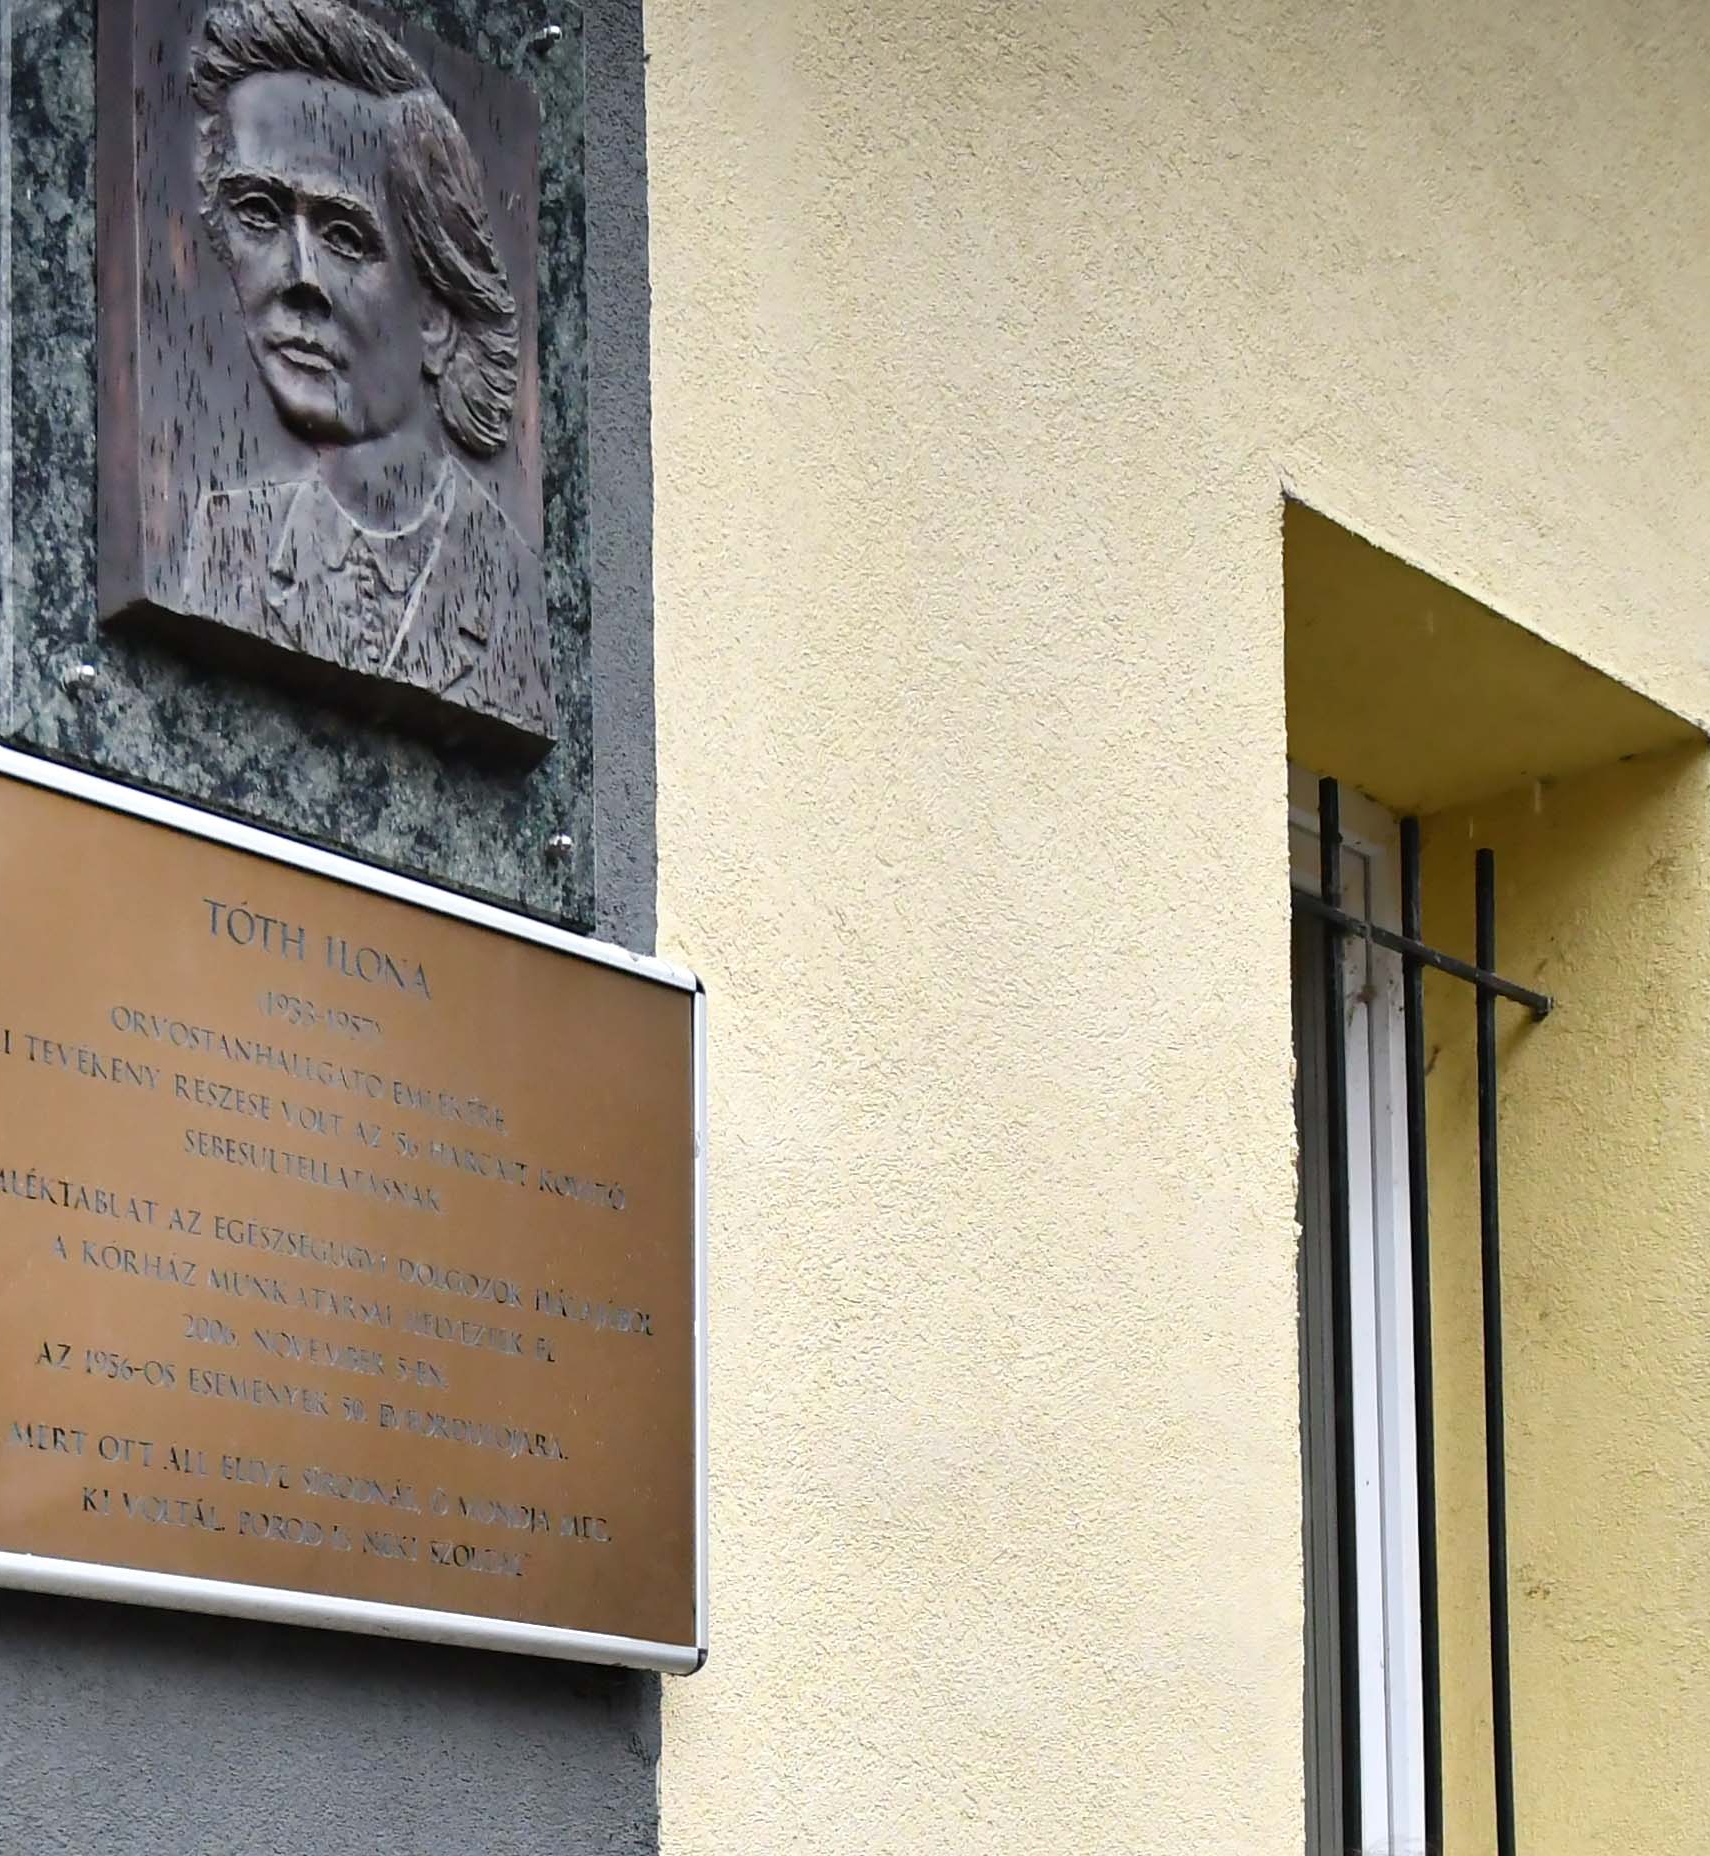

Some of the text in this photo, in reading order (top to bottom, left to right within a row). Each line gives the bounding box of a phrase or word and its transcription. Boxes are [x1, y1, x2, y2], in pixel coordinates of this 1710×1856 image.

[201, 898, 433, 999] TÓTH ILONA
[280, 1102, 345, 1137] VOLT
[353, 1122, 381, 1147] AZ
[168, 1207, 201, 1233] AZ
[53, 1237, 68, 1258] A
[82, 1242, 198, 1285] KÓRHÁZ
[37, 1342, 72, 1370] AZ
[84, 1351, 176, 1388] 1956-OS
[97, 1437, 153, 1467] OTT
[80, 1488, 112, 1514] KI
